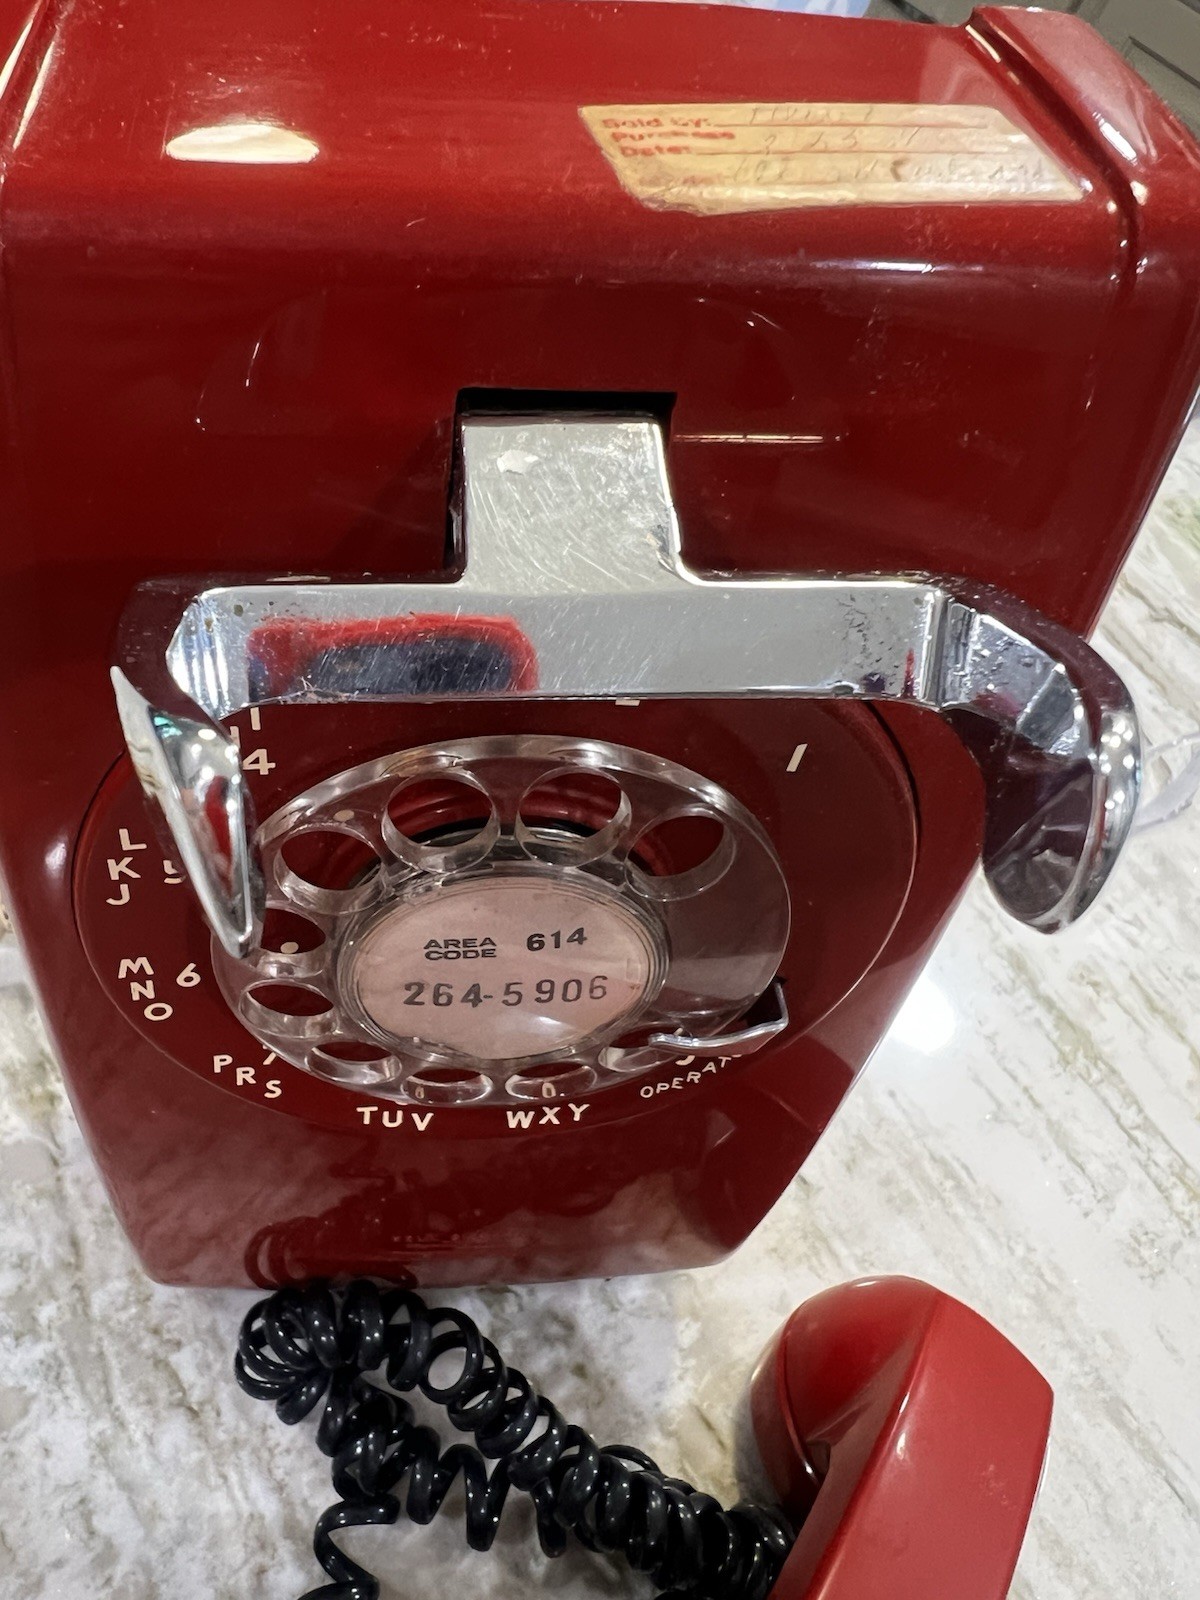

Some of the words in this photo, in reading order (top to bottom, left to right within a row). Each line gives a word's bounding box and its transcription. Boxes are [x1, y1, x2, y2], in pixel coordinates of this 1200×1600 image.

[242, 748, 276, 775] 4
[424, 937, 497, 950] AREA
[526, 927, 587, 951] 614
[424, 949, 497, 960] CODE
[176, 963, 201, 988] 6
[403, 975, 608, 1008] 264-5906
[212, 1054, 282, 1098] PRS
[640, 1054, 743, 1098] OPERAT
[356, 1106, 434, 1132] TUV
[506, 1103, 590, 1129] WXY
